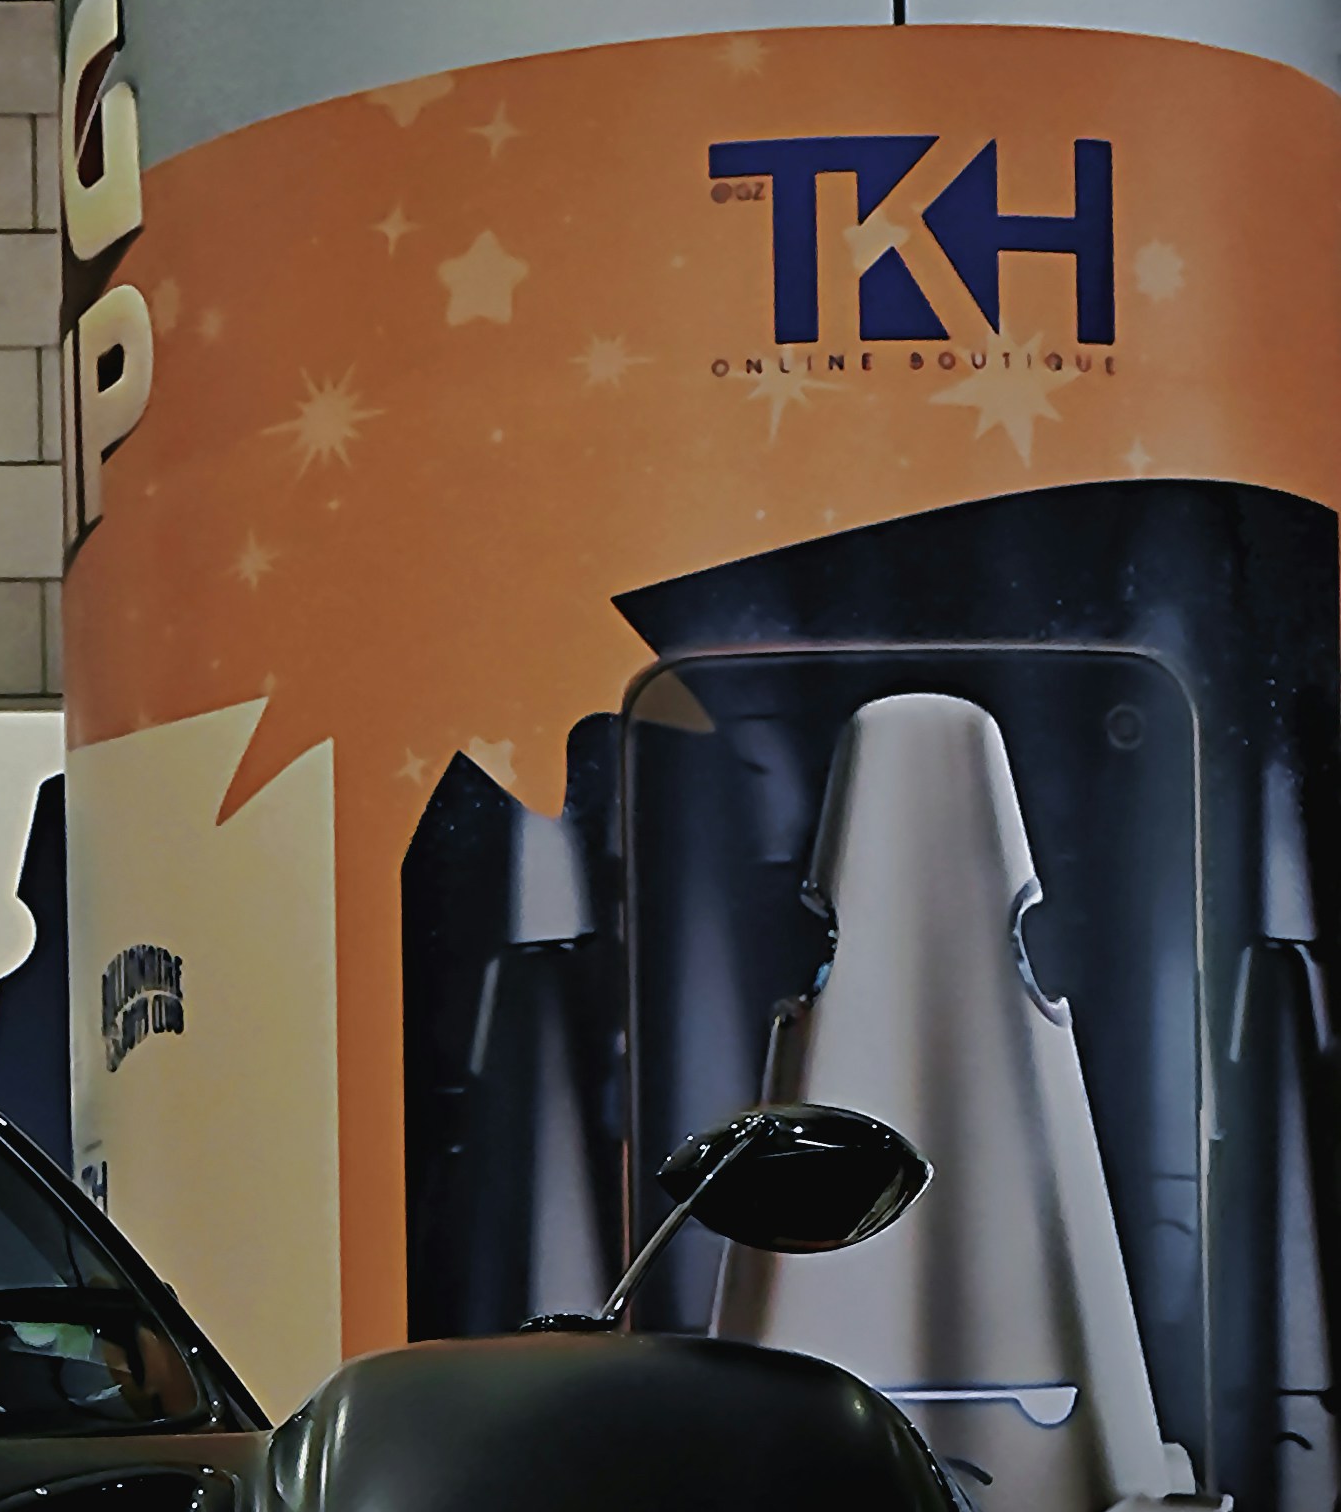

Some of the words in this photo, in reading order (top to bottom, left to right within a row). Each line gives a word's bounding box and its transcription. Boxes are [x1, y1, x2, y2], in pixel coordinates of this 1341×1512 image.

[708, 135, 1115, 346] TKH
[711, 352, 874, 378] ONLINE
[909, 351, 1116, 376] BOUTIQUE
